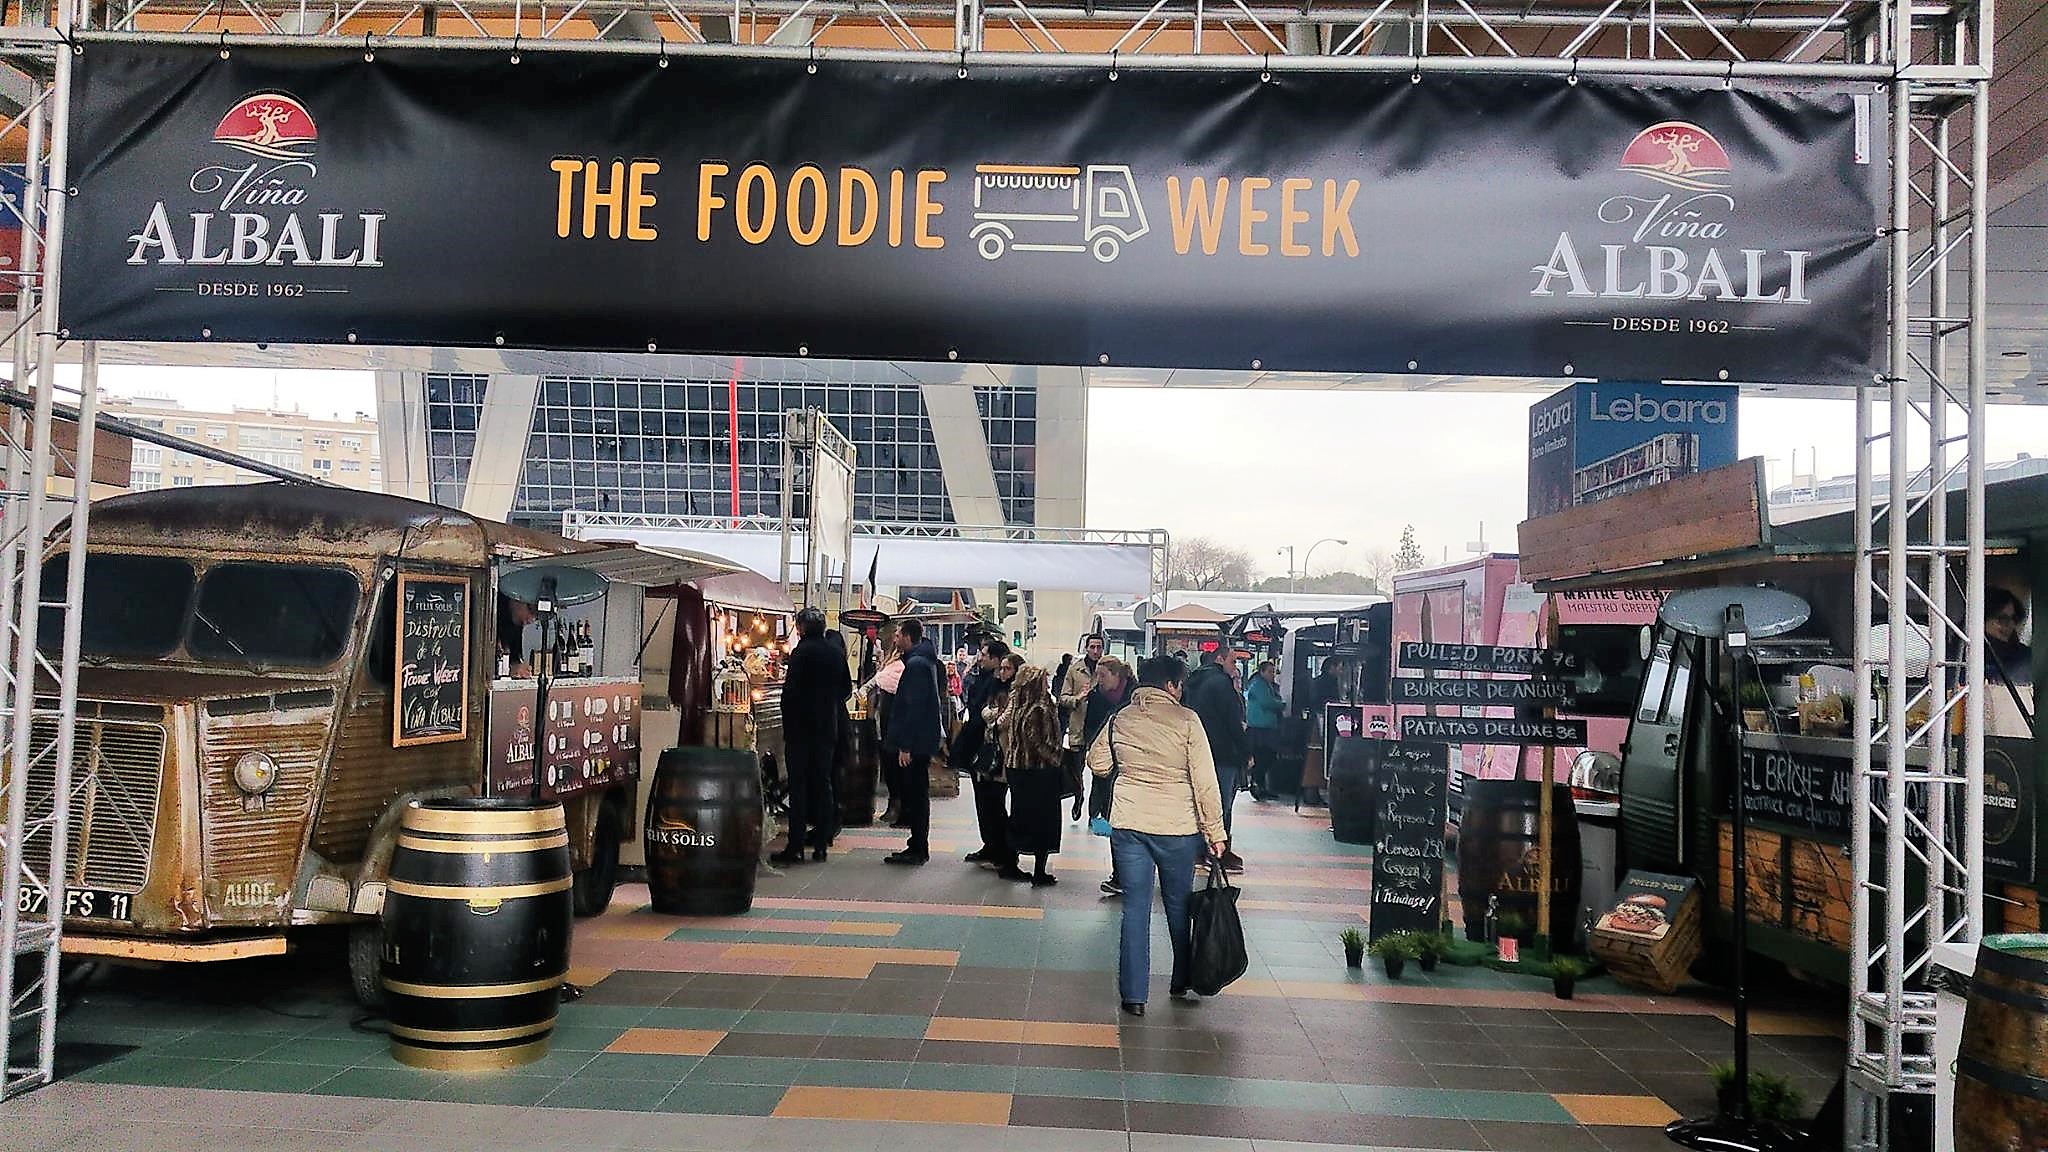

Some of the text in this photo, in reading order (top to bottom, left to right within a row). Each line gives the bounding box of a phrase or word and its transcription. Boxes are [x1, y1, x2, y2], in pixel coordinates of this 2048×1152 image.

[190, 160, 317, 211] Viña
[551, 160, 1360, 257] THE FOODIE WEEK
[1597, 192, 1735, 244] Viña
[127, 200, 386, 268] ALBALI
[1531, 230, 1811, 305] ALBALI
[198, 281, 304, 298] DESDE 1962
[1612, 316, 1730, 334] DESDE 1962
[1532, 400, 1571, 438] Lebara
[1590, 392, 1727, 424] Lebara
[1567, 602, 1619, 614] MAESTRO
[1407, 644, 1478, 662] PULLED
[1492, 647, 1545, 665] PORK
[1404, 682, 1567, 699] BURGER DE ANGUS
[1404, 720, 1478, 736] PATATAS
[1485, 722, 1553, 738] DELUXE
[506, 742, 535, 764] ALBAL
[671, 833, 715, 847] SOLIS
[65, 889, 95, 917] FS
[110, 894, 128, 921] 11
[223, 881, 276, 907] AUDE
